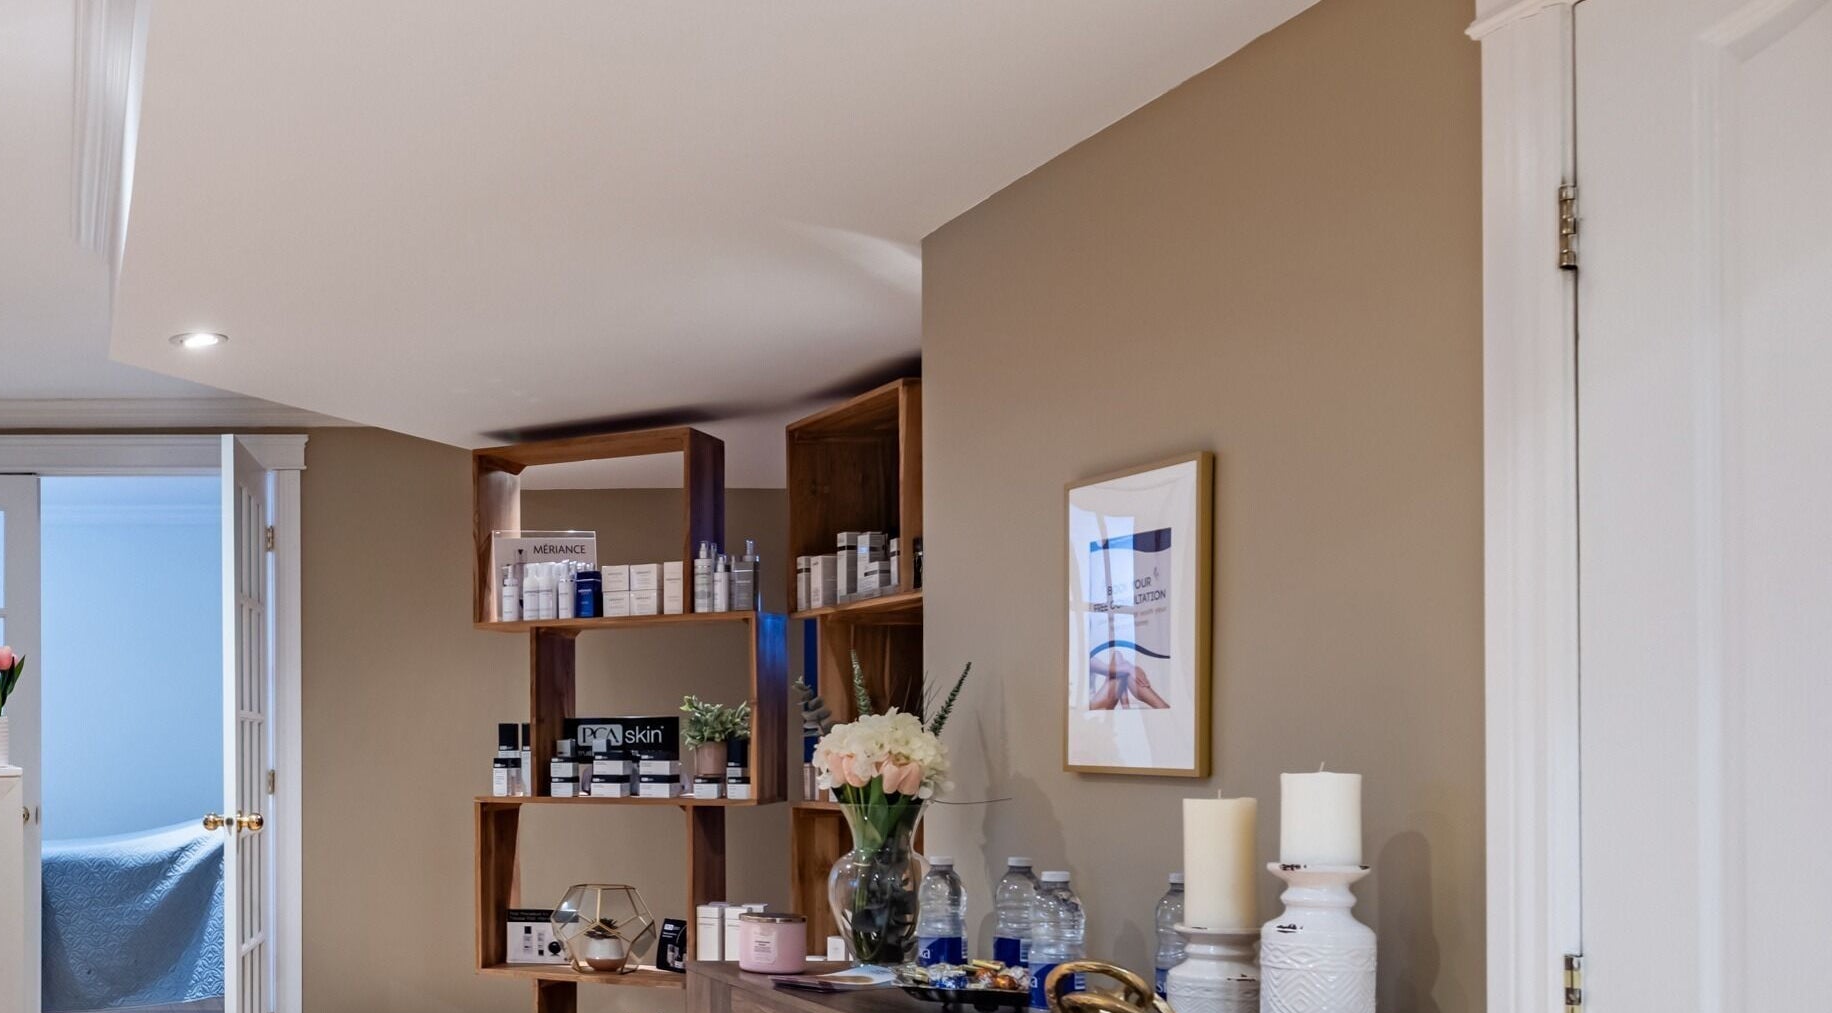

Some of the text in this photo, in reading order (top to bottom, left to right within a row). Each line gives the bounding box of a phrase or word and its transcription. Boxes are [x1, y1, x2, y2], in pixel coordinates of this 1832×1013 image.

[533, 544, 586, 554] MÉRIANCE
[582, 726, 662, 743] PCA skin
